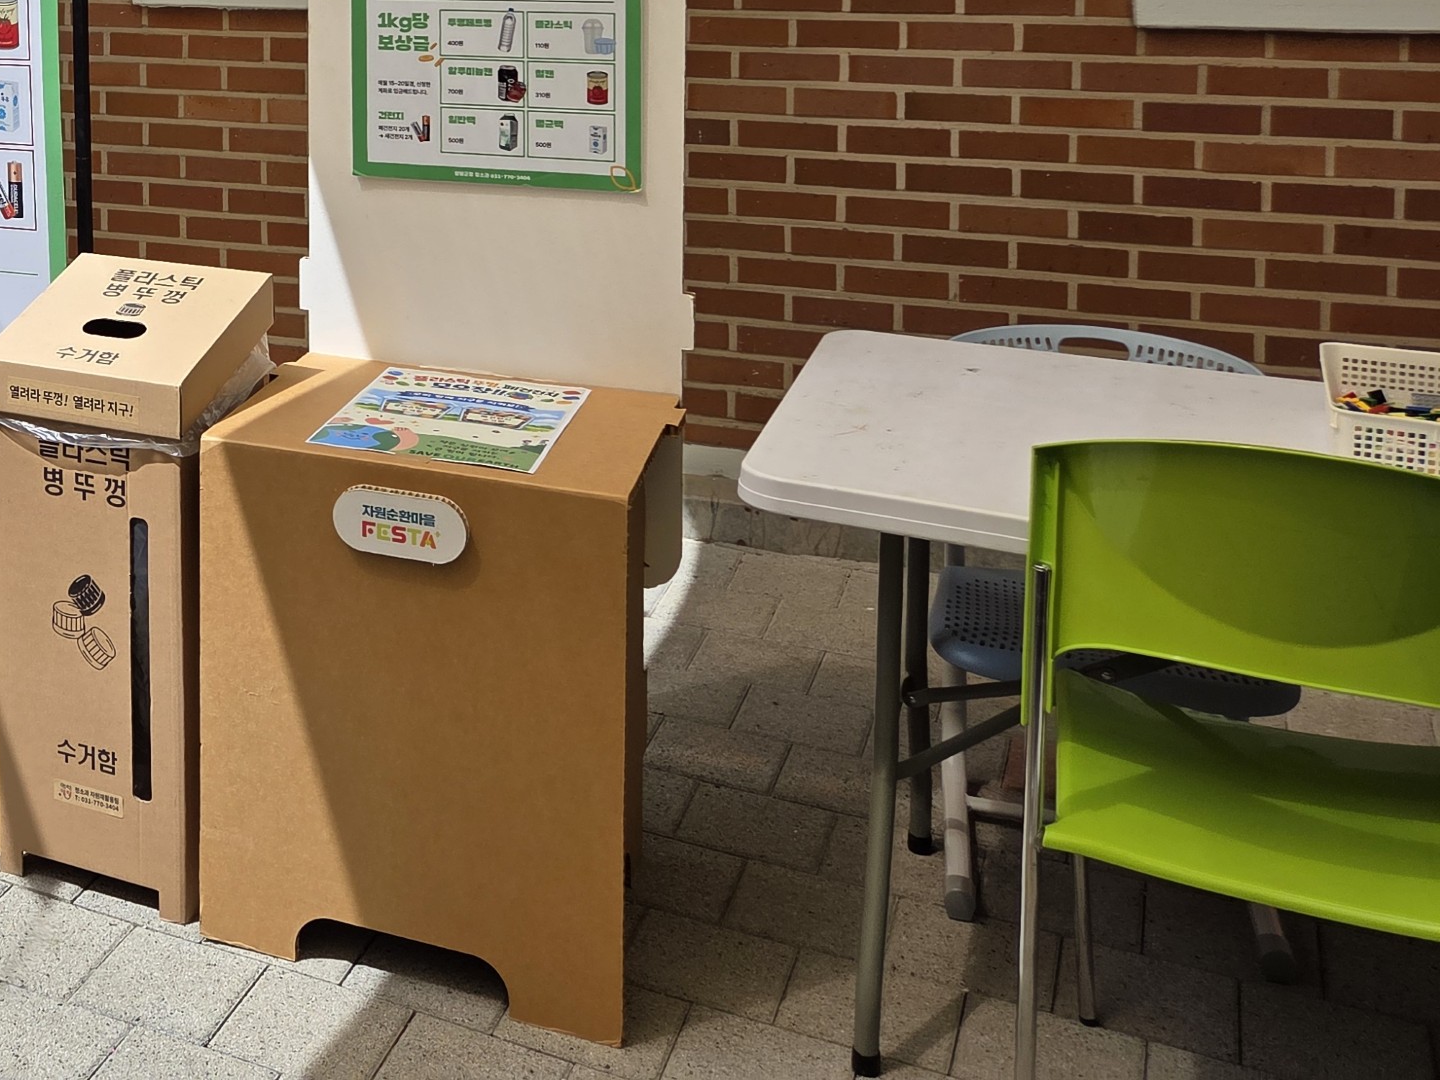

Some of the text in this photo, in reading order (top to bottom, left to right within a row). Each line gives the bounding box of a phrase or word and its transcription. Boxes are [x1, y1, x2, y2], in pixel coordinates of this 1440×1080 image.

[377, 12, 429, 33] 1kg당
[535, 20, 573, 29] 플라스틱
[377, 35, 429, 52] 보상금
[378, 111, 404, 120] 건전지
[110, 268, 205, 291] 플라스틱
[56, 346, 120, 366] 수거함
[9, 384, 134, 418] 열려라 뚜껑! 열려라 지구!
[409, 449, 440, 457] SAVE
[362, 505, 435, 527] 자원순환마을
[362, 521, 437, 550] FESTA
[57, 739, 118, 776] 수거함
